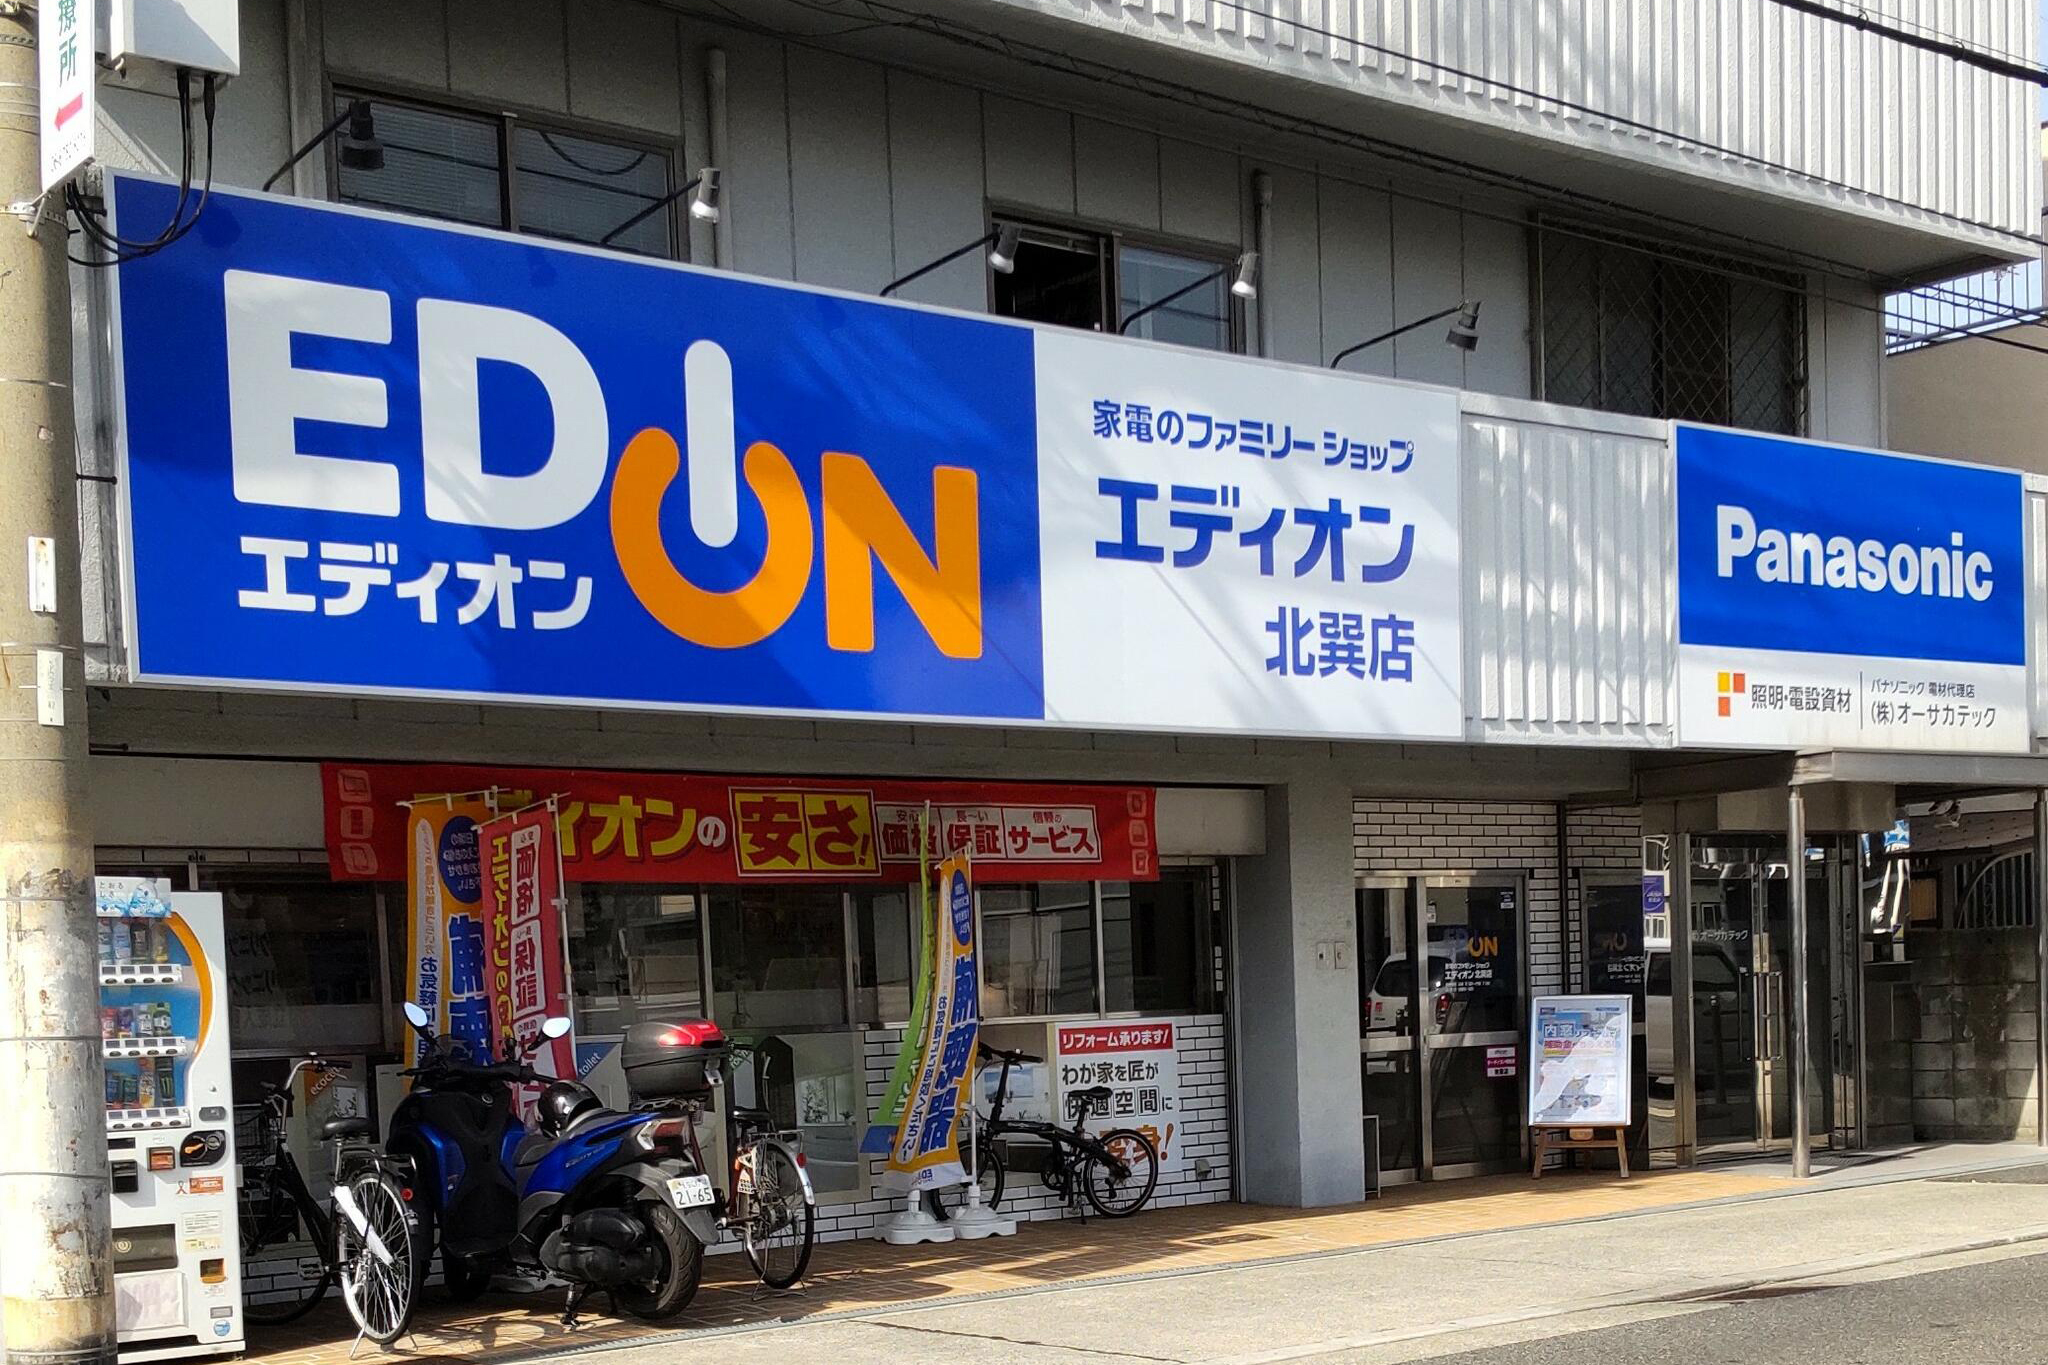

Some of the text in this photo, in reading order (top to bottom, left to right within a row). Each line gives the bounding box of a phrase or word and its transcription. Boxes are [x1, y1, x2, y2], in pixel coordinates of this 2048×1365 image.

[224, 269, 982, 659] EDION
[1092, 400, 1415, 473] 家電のファミリーショップ
[1095, 477, 1416, 583] エディオン
[1717, 505, 1994, 602] Panasonic
[239, 536, 593, 631] エディオン
[1265, 606, 1415, 682] 北巽店
[1871, 679, 1976, 699] パナソニック 電材代理店
[947, 824, 1002, 855] 保証
[1008, 824, 1096, 855] サービス
[1062, 1060, 1159, 1085] わが家を匠が
